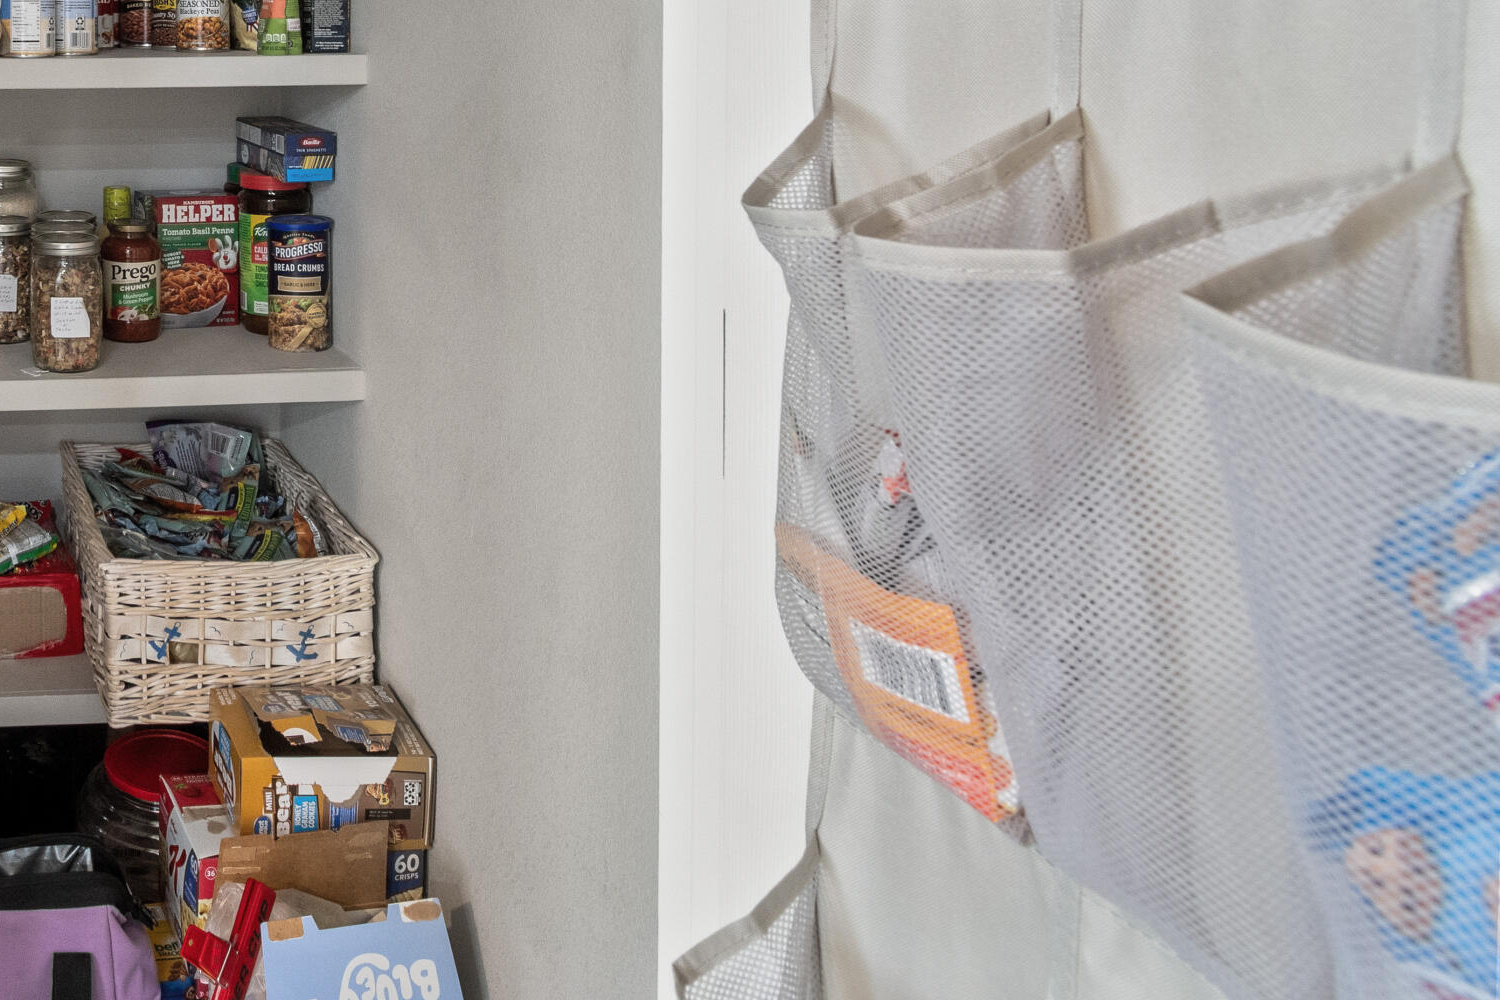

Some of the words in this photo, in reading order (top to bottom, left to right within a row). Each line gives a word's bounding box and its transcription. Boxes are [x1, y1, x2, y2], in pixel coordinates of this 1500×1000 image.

[180, 7, 205, 15] Blackeye
[162, 204, 236, 223] HELPER
[162, 228, 191, 236] Tomato
[192, 227, 210, 235] Basil
[275, 242, 323, 259] PROGRESSO
[274, 263, 295, 272] BREAD
[297, 263, 324, 272] CRUMBS
[111, 264, 156, 283] Prego
[119, 283, 151, 292] CHUNKY
[123, 292, 149, 300] Mushroom
[394, 854, 420, 874] 60
[206, 870, 216, 878] 36
[394, 872, 419, 881] CRISPS
